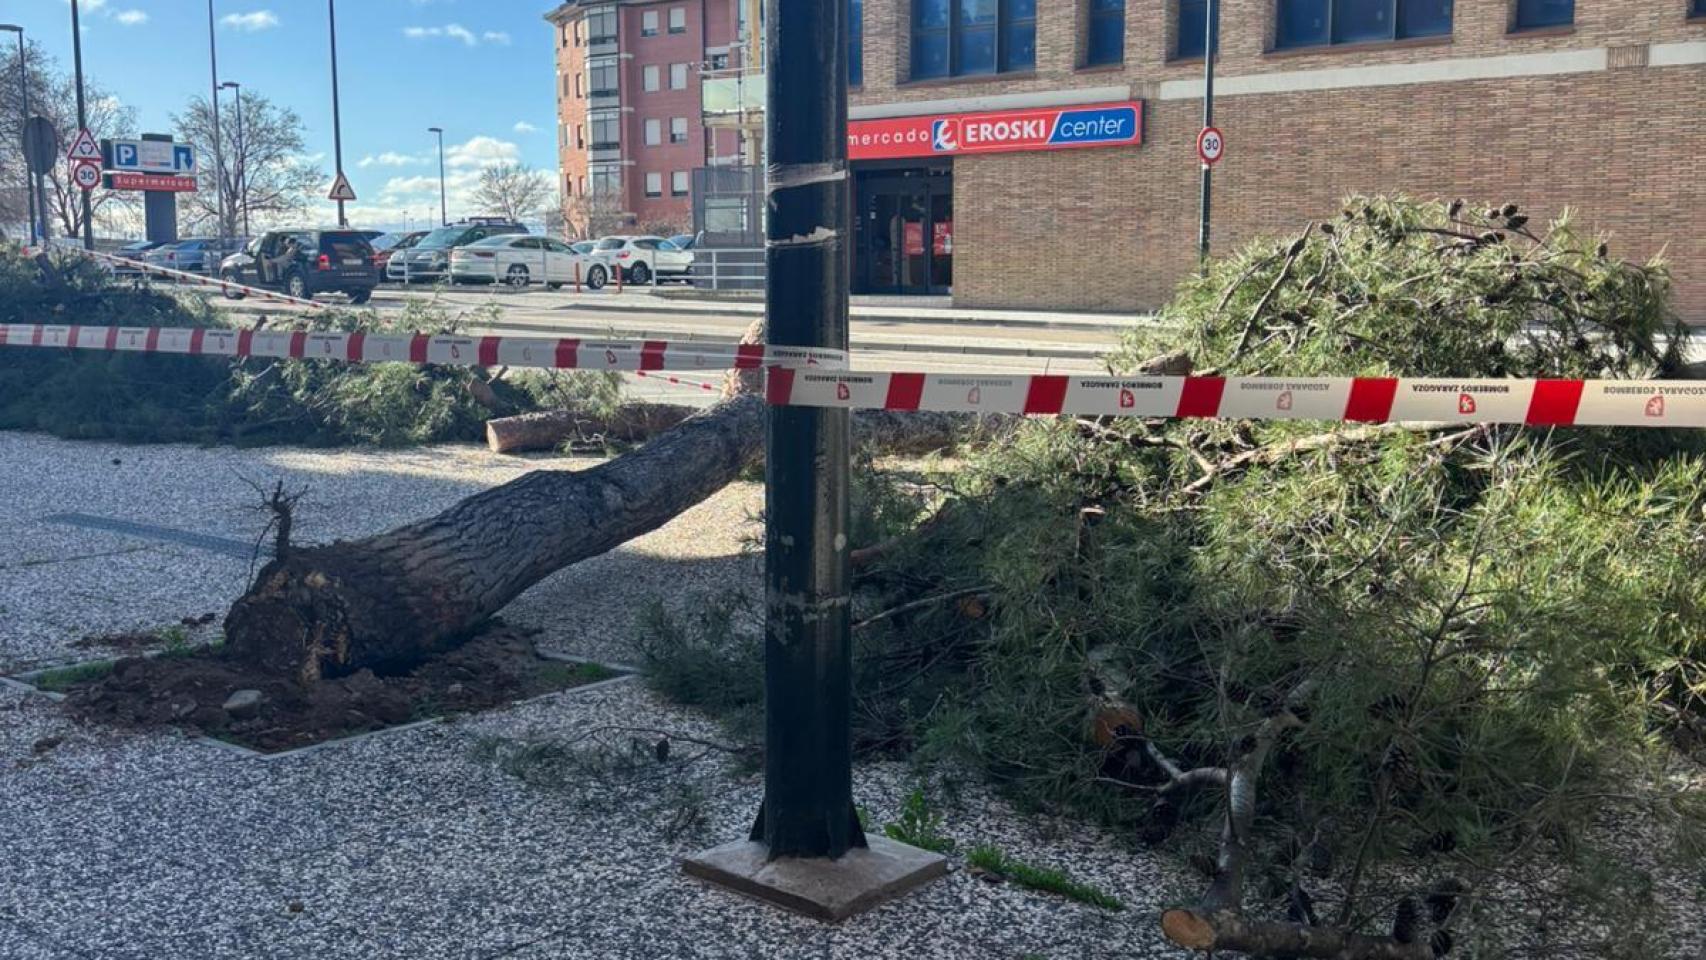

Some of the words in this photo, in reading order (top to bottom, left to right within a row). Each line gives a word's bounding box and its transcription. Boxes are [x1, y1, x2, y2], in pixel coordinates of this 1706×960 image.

[966, 119, 1046, 142] EROSKI
[1060, 116, 1126, 138] center
[1204, 138, 1219, 150] 30
[120, 145, 134, 164] P
[80, 169, 95, 180] 30
[1412, 383, 1459, 392] ZARAGOZA
[1461, 384, 1510, 393] BOMBEROS
